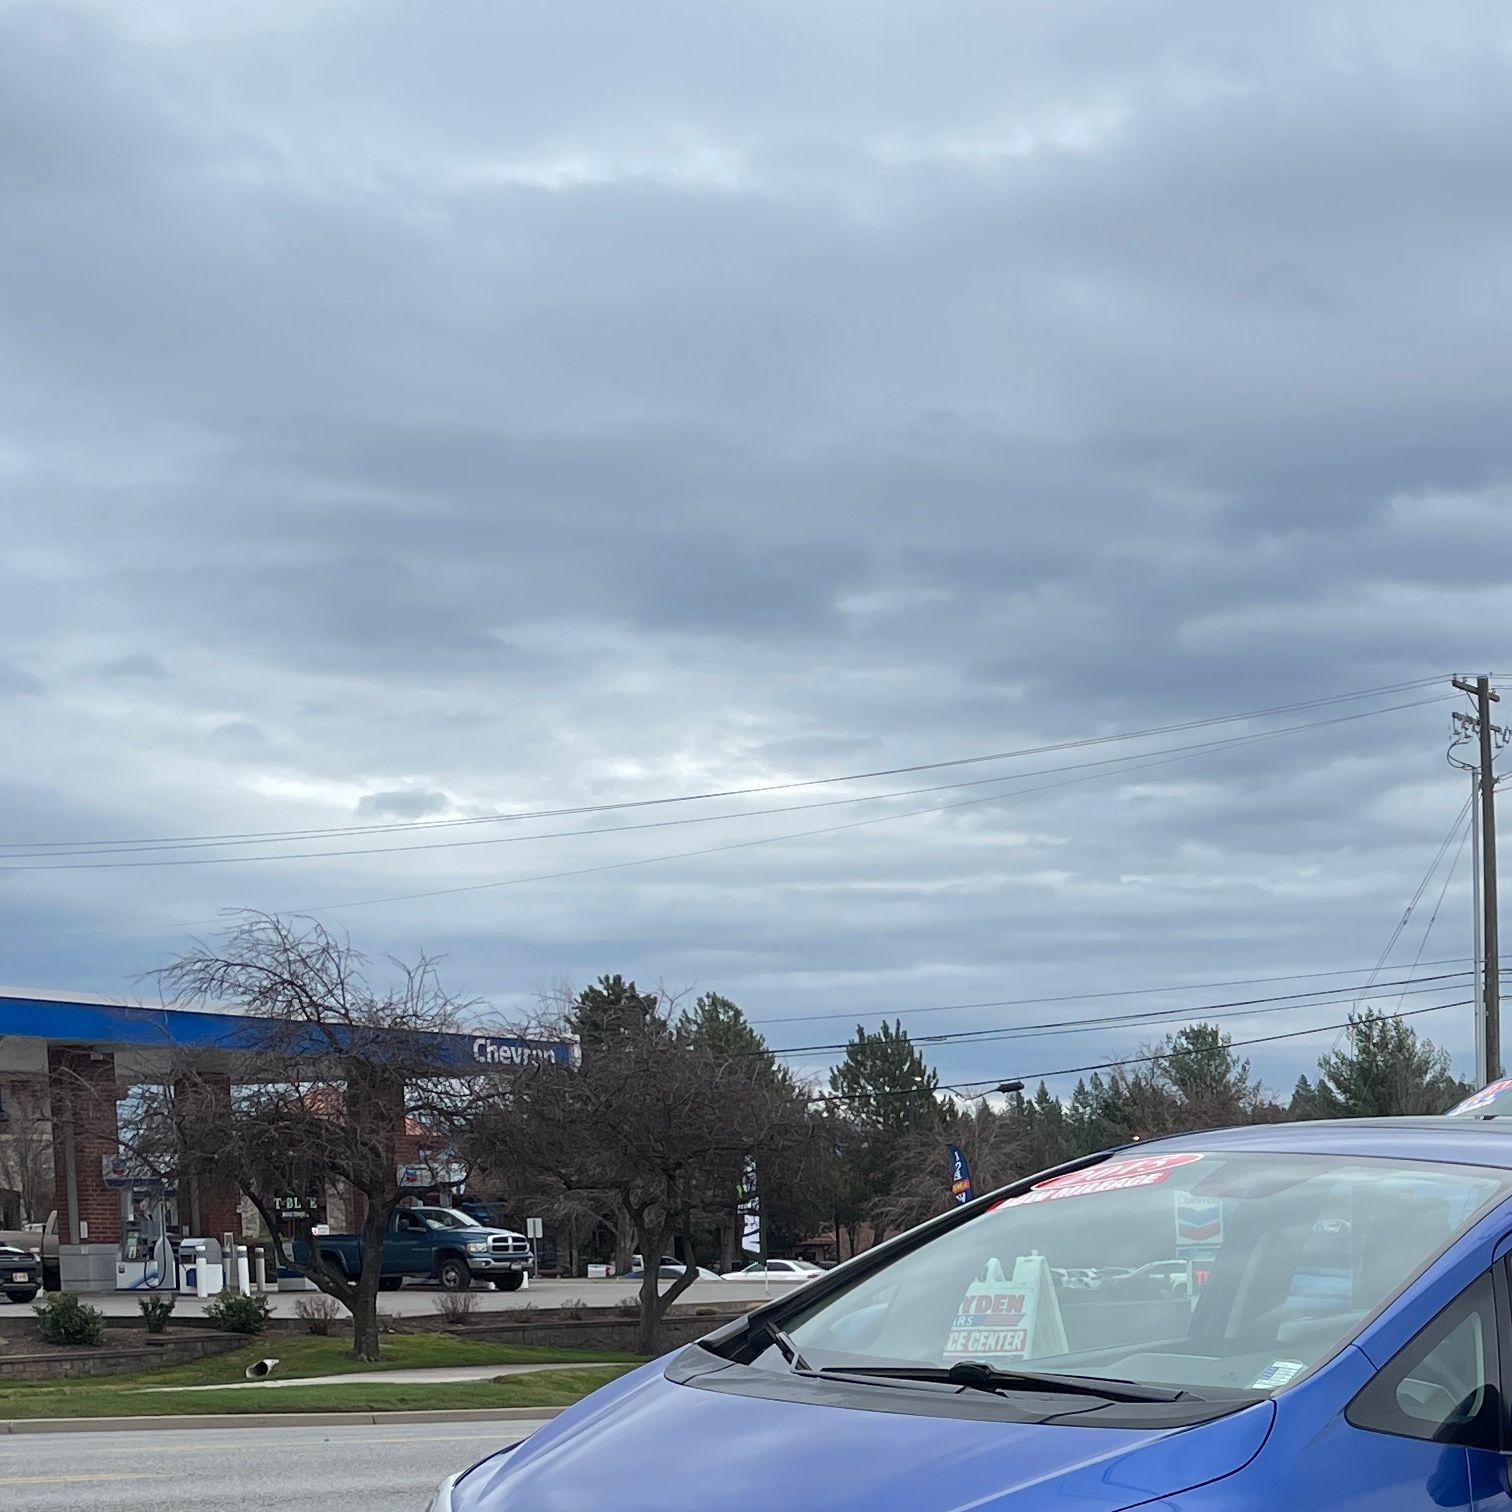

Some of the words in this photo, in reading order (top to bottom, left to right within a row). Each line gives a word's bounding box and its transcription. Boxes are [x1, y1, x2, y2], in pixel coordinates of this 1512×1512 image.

[473, 1038, 556, 1067] Chevron
[1051, 1172, 1163, 1199] MILEAGE
[967, 1331, 1025, 1352] CENTER
